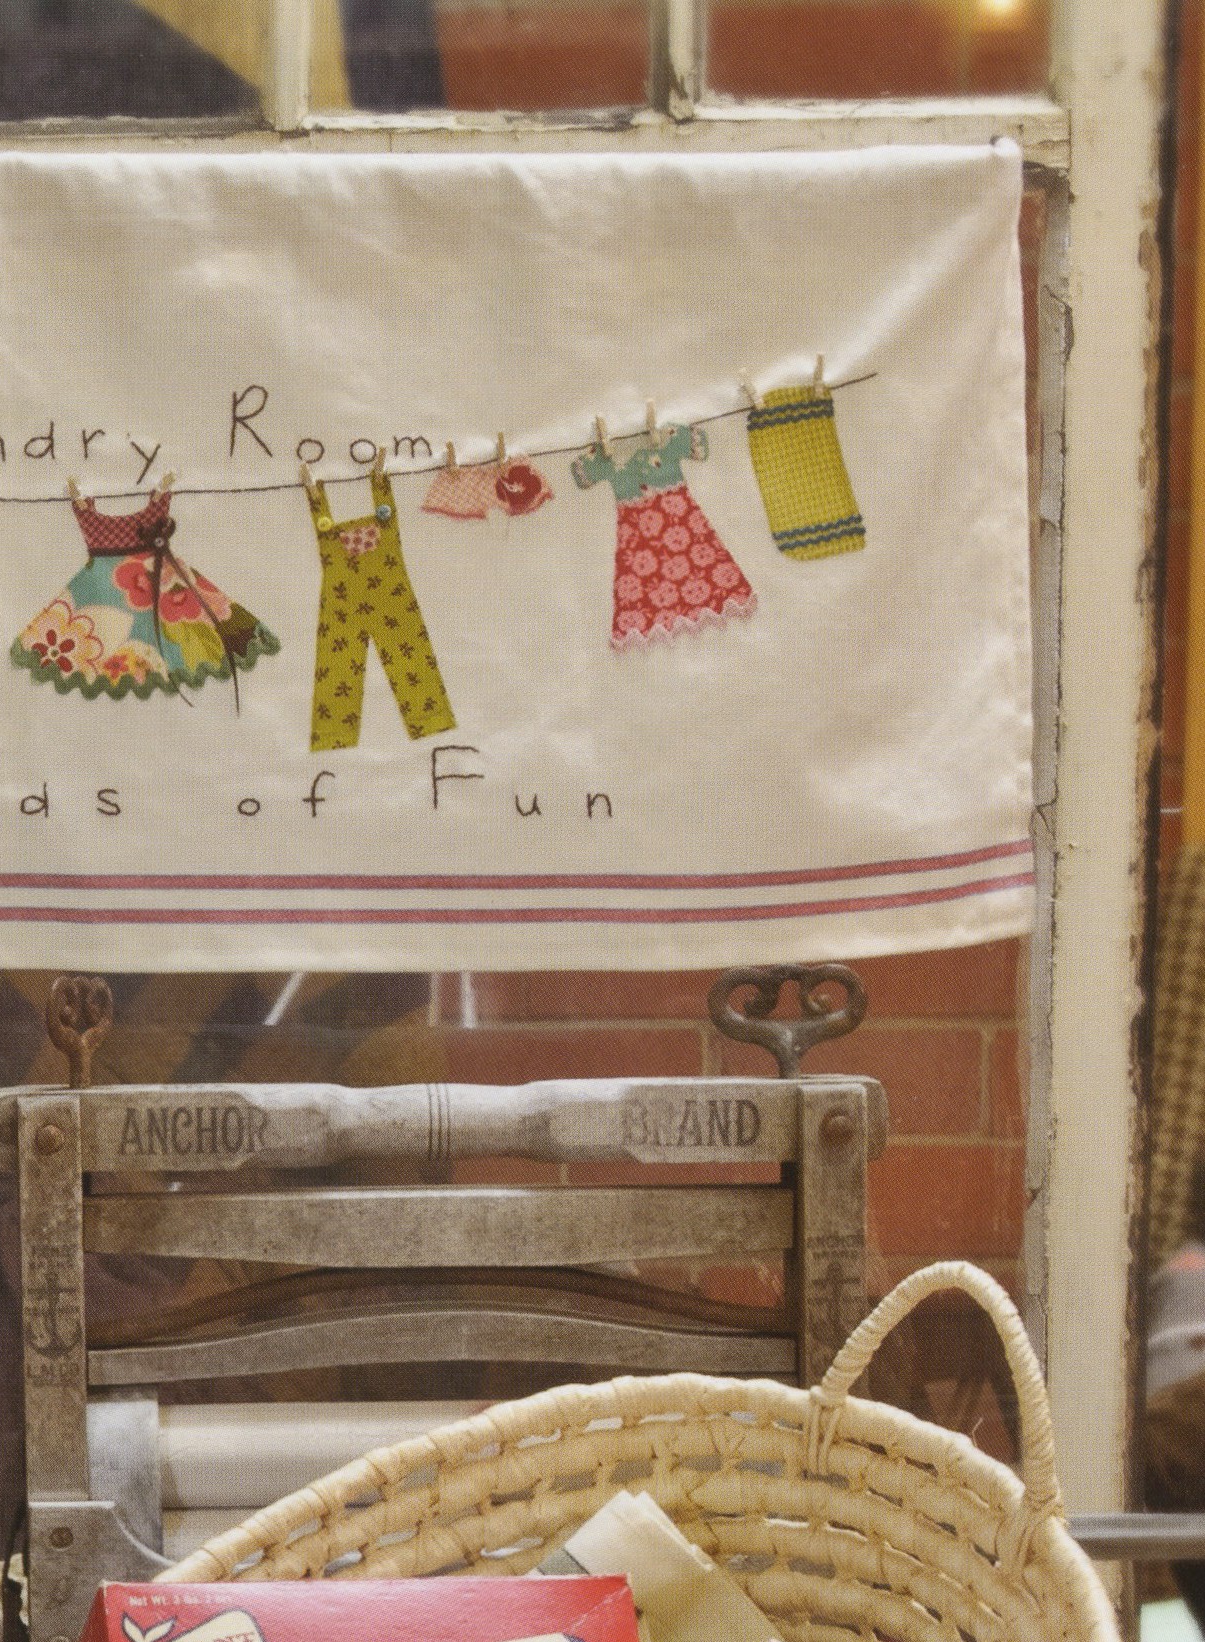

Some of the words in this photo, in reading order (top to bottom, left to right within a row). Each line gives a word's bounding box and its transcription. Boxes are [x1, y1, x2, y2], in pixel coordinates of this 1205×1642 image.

[229, 384, 433, 466] Room
[236, 770, 336, 819] of
[430, 745, 614, 820] Fun
[117, 1105, 271, 1156] ANCHOR
